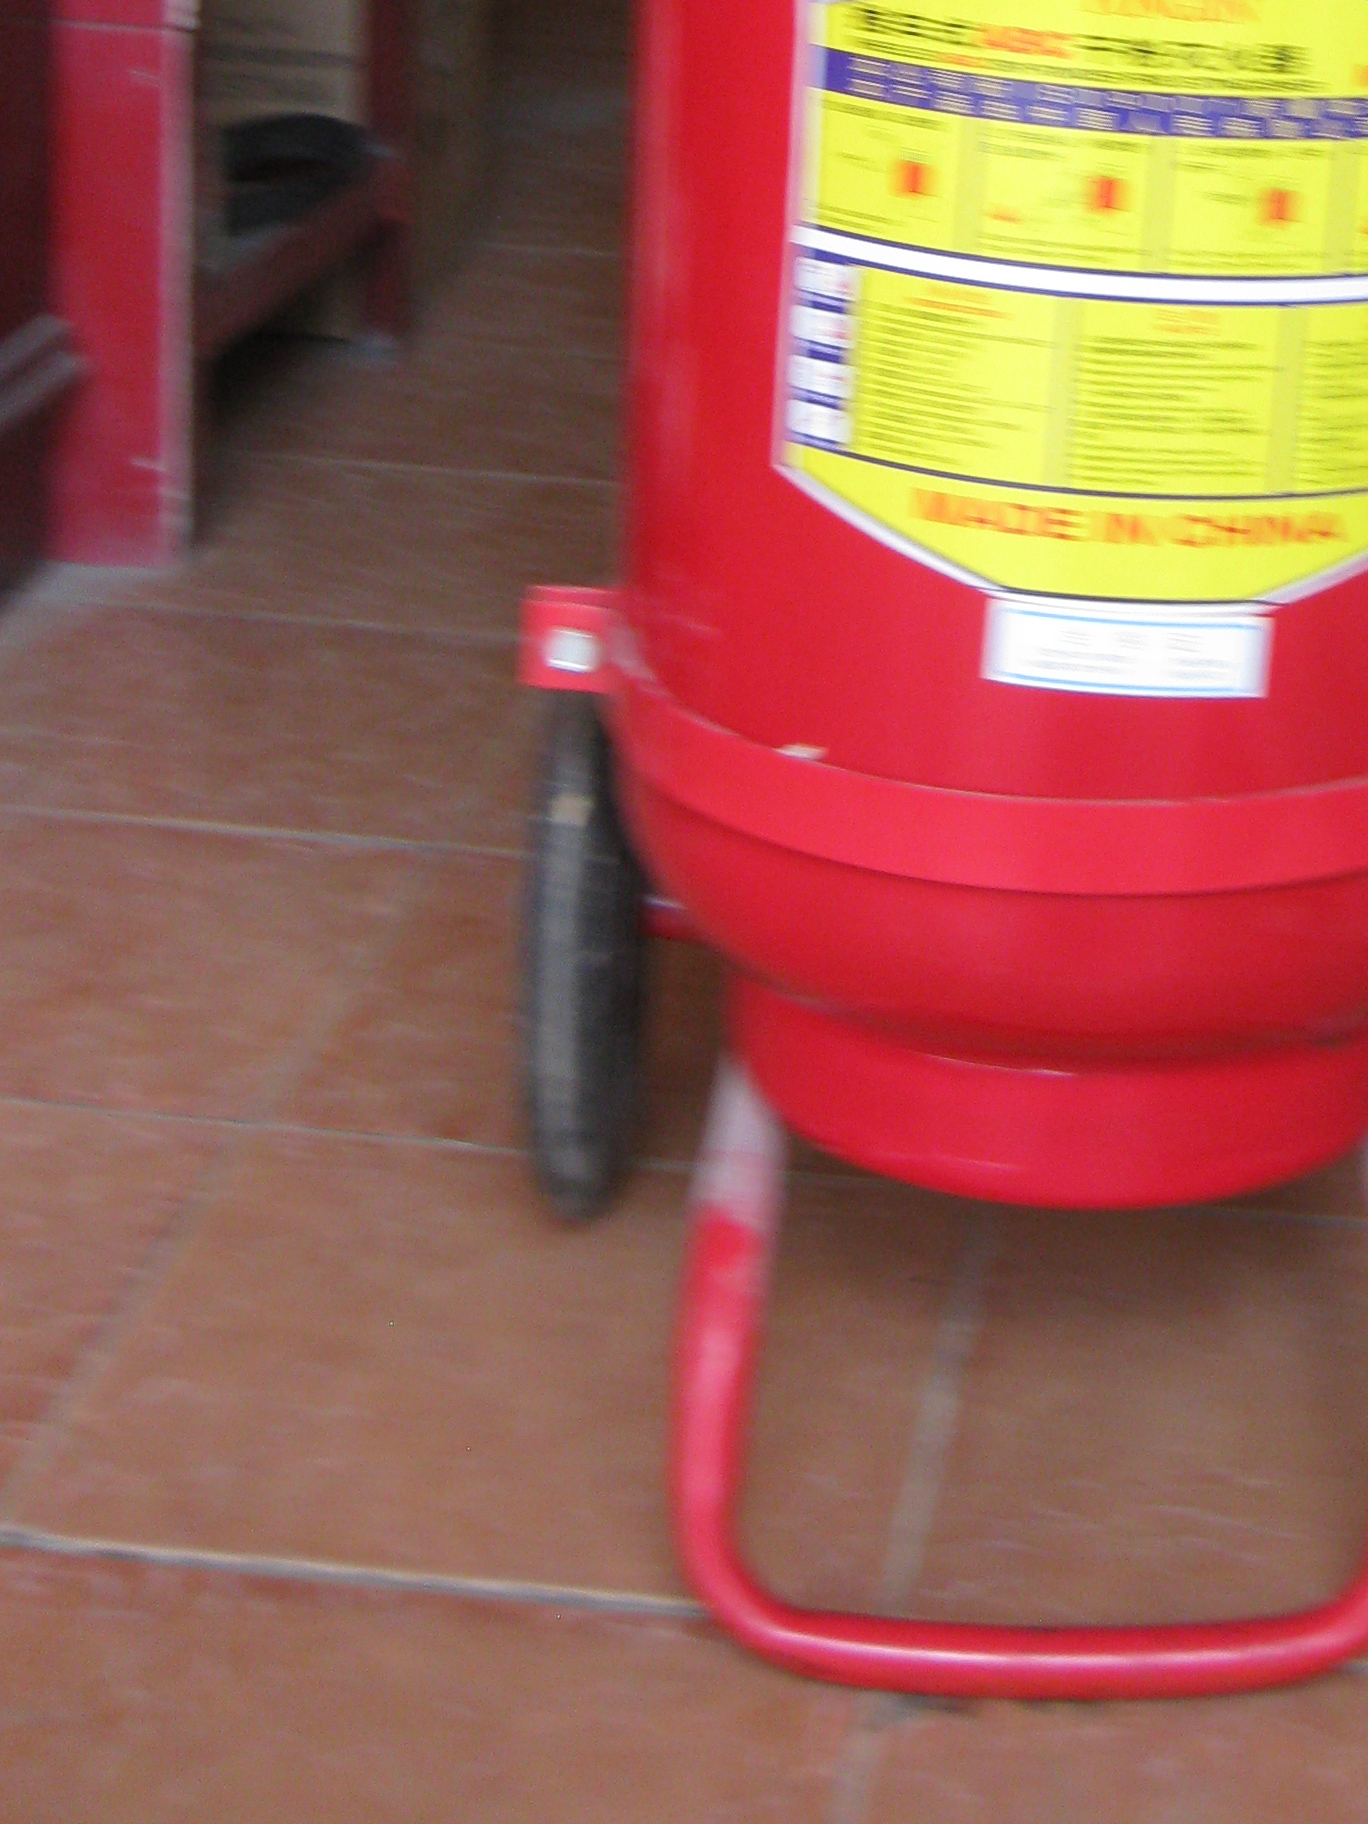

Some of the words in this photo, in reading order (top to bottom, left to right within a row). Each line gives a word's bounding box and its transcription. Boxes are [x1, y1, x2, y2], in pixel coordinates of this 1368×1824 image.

[909, 488, 1086, 542] MADE
[1094, 511, 1158, 547] IN
[1169, 510, 1347, 548] CHINA
